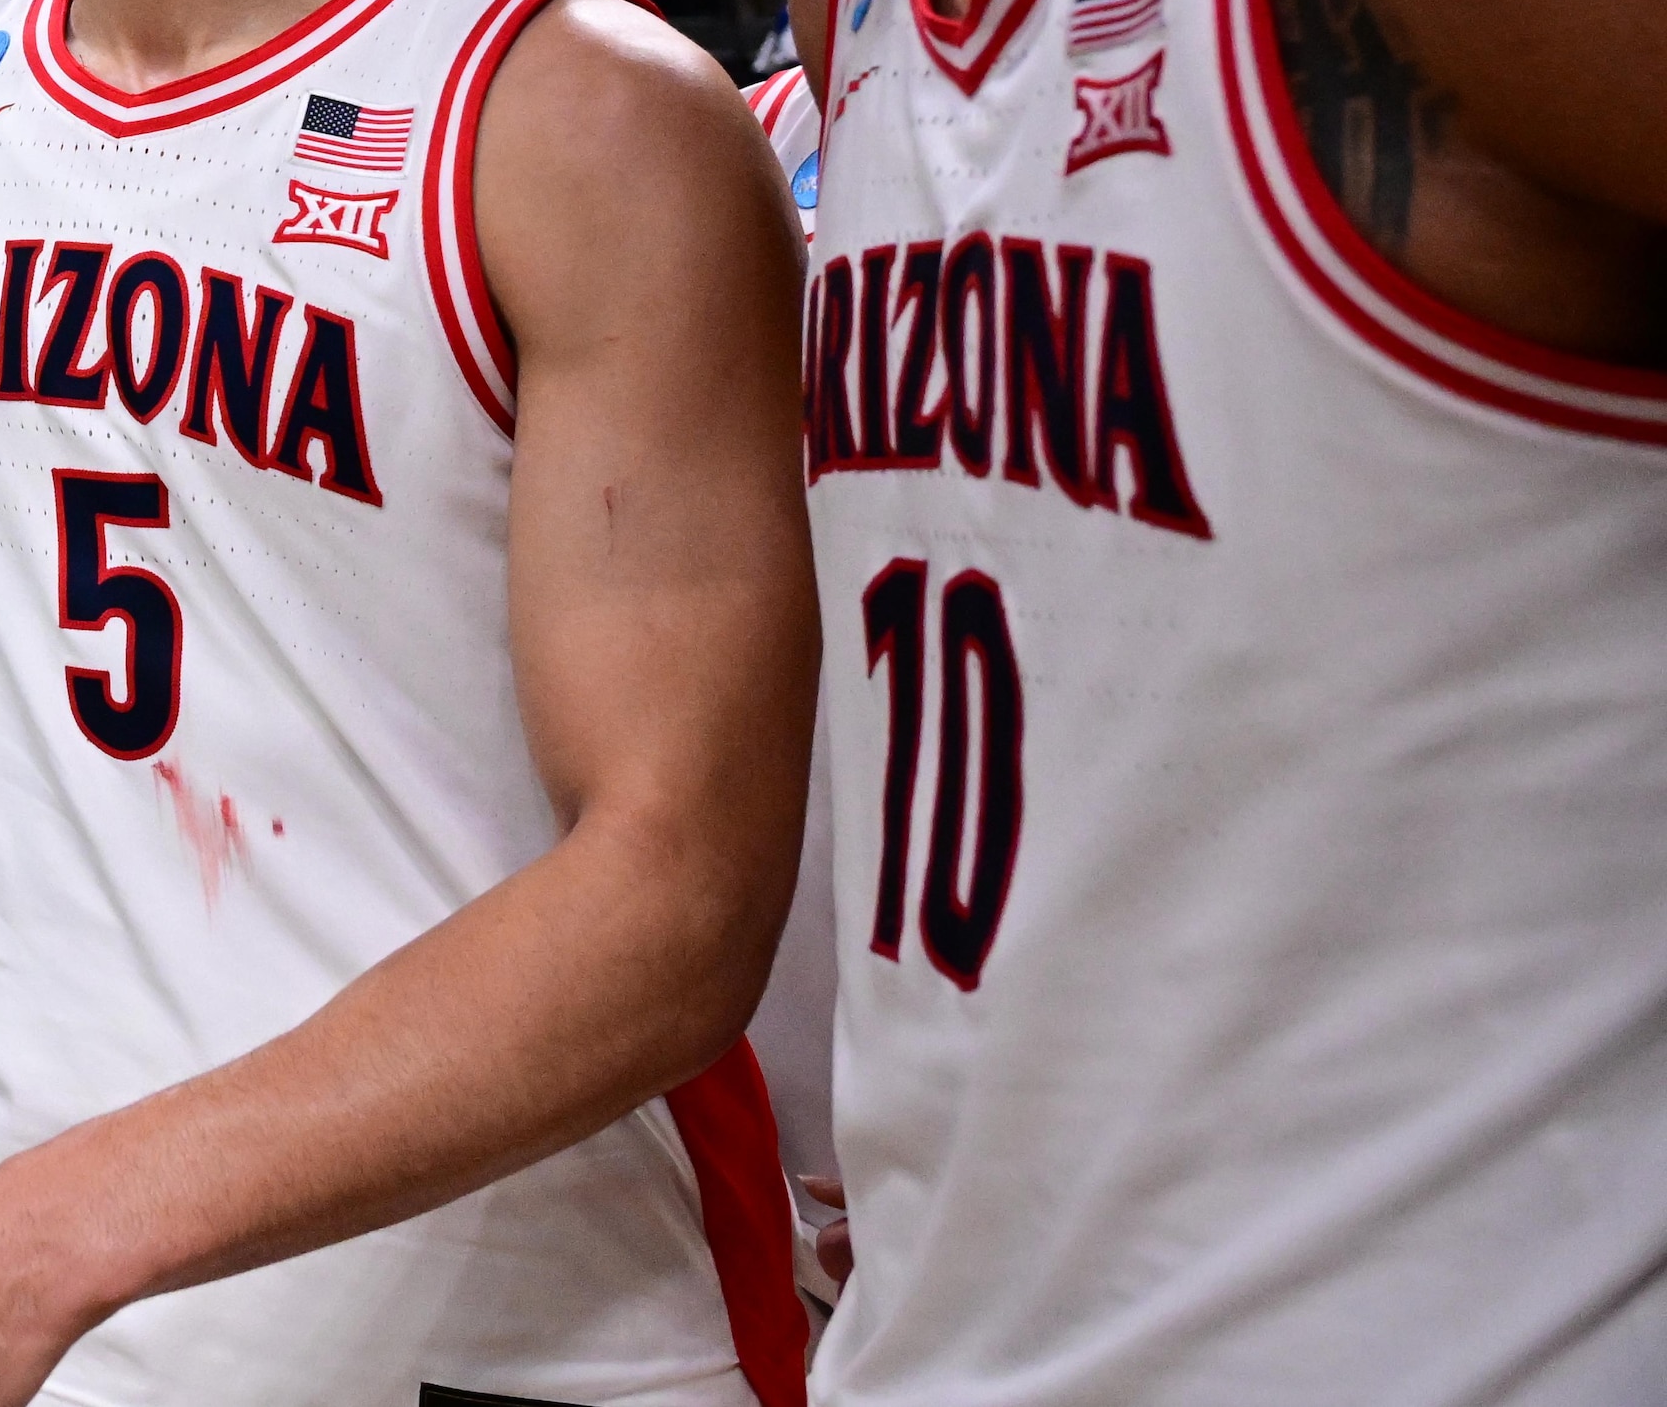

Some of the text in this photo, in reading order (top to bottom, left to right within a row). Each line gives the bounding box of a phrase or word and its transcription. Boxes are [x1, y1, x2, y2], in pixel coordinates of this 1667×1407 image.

[276, 181, 395, 257] XII
[51, 467, 184, 762] 5
[861, 555, 1025, 992] 10
